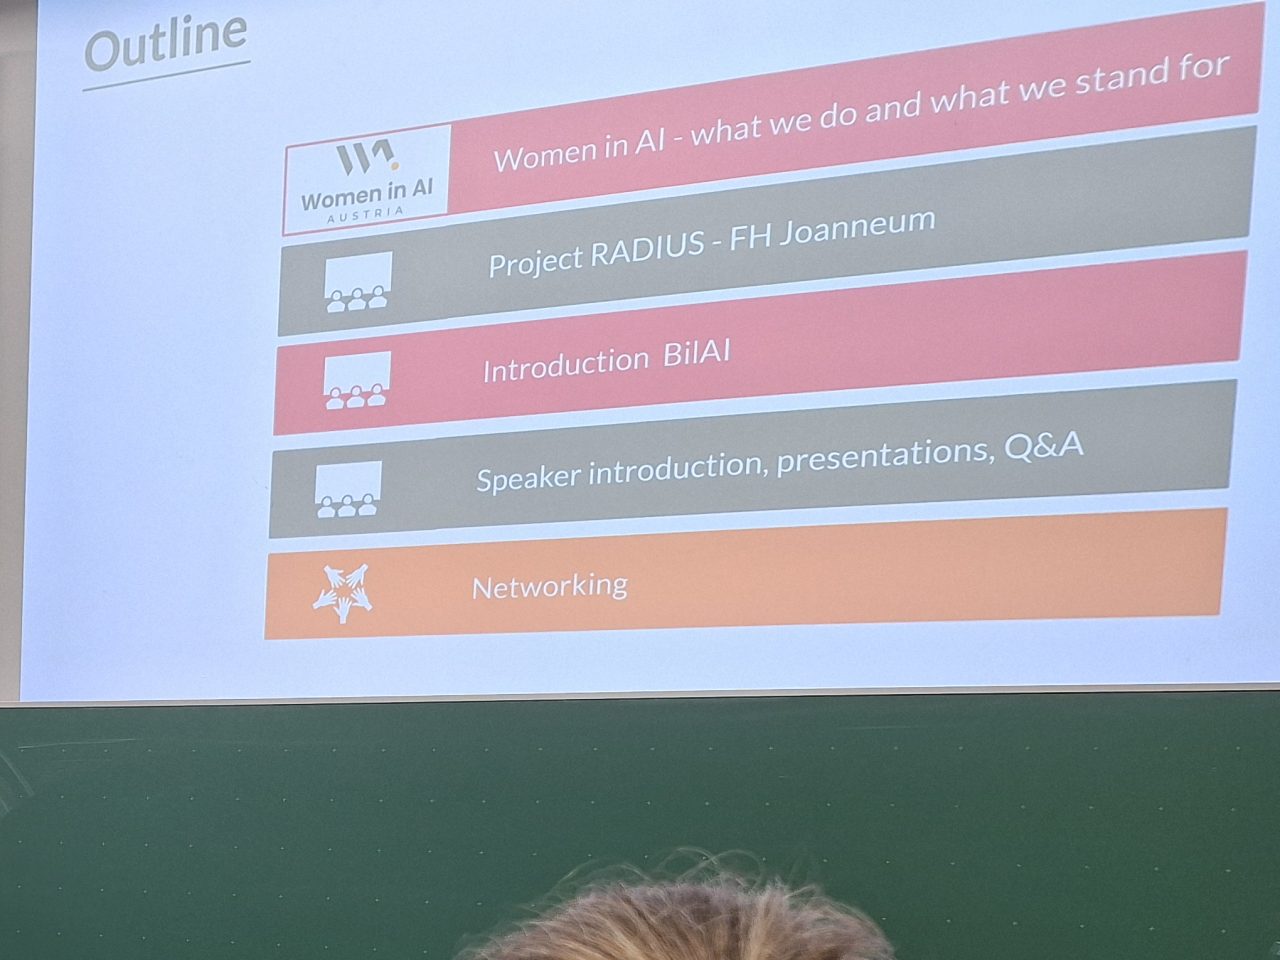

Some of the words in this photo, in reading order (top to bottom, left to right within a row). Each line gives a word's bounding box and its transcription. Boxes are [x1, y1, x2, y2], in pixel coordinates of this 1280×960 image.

[84, 14, 248, 73] Outline
[493, 135, 598, 173] Women
[604, 133, 628, 159] in
[635, 128, 665, 154] AI
[691, 114, 763, 147] what
[769, 111, 812, 136] we
[820, 102, 856, 129] do
[865, 93, 921, 123] and
[931, 81, 1010, 114] what
[1019, 75, 1066, 102] we
[1076, 56, 1169, 95] stand
[1179, 51, 1231, 81] for
[301, 188, 381, 211] Women
[388, 181, 406, 200] in
[413, 177, 433, 196] AI
[327, 206, 403, 225] AUSTRIA
[489, 247, 583, 279] Project
[591, 230, 705, 266] RADIUS
[730, 222, 771, 252] FH
[780, 208, 936, 246] Joanneum
[483, 349, 649, 383] Introduction
[663, 338, 731, 367] BilAI
[477, 464, 581, 497] Speaker
[589, 451, 769, 486] introduction,
[777, 438, 995, 478] presentations,
[1004, 430, 1084, 463] Q&A
[472, 572, 628, 603] Networking
